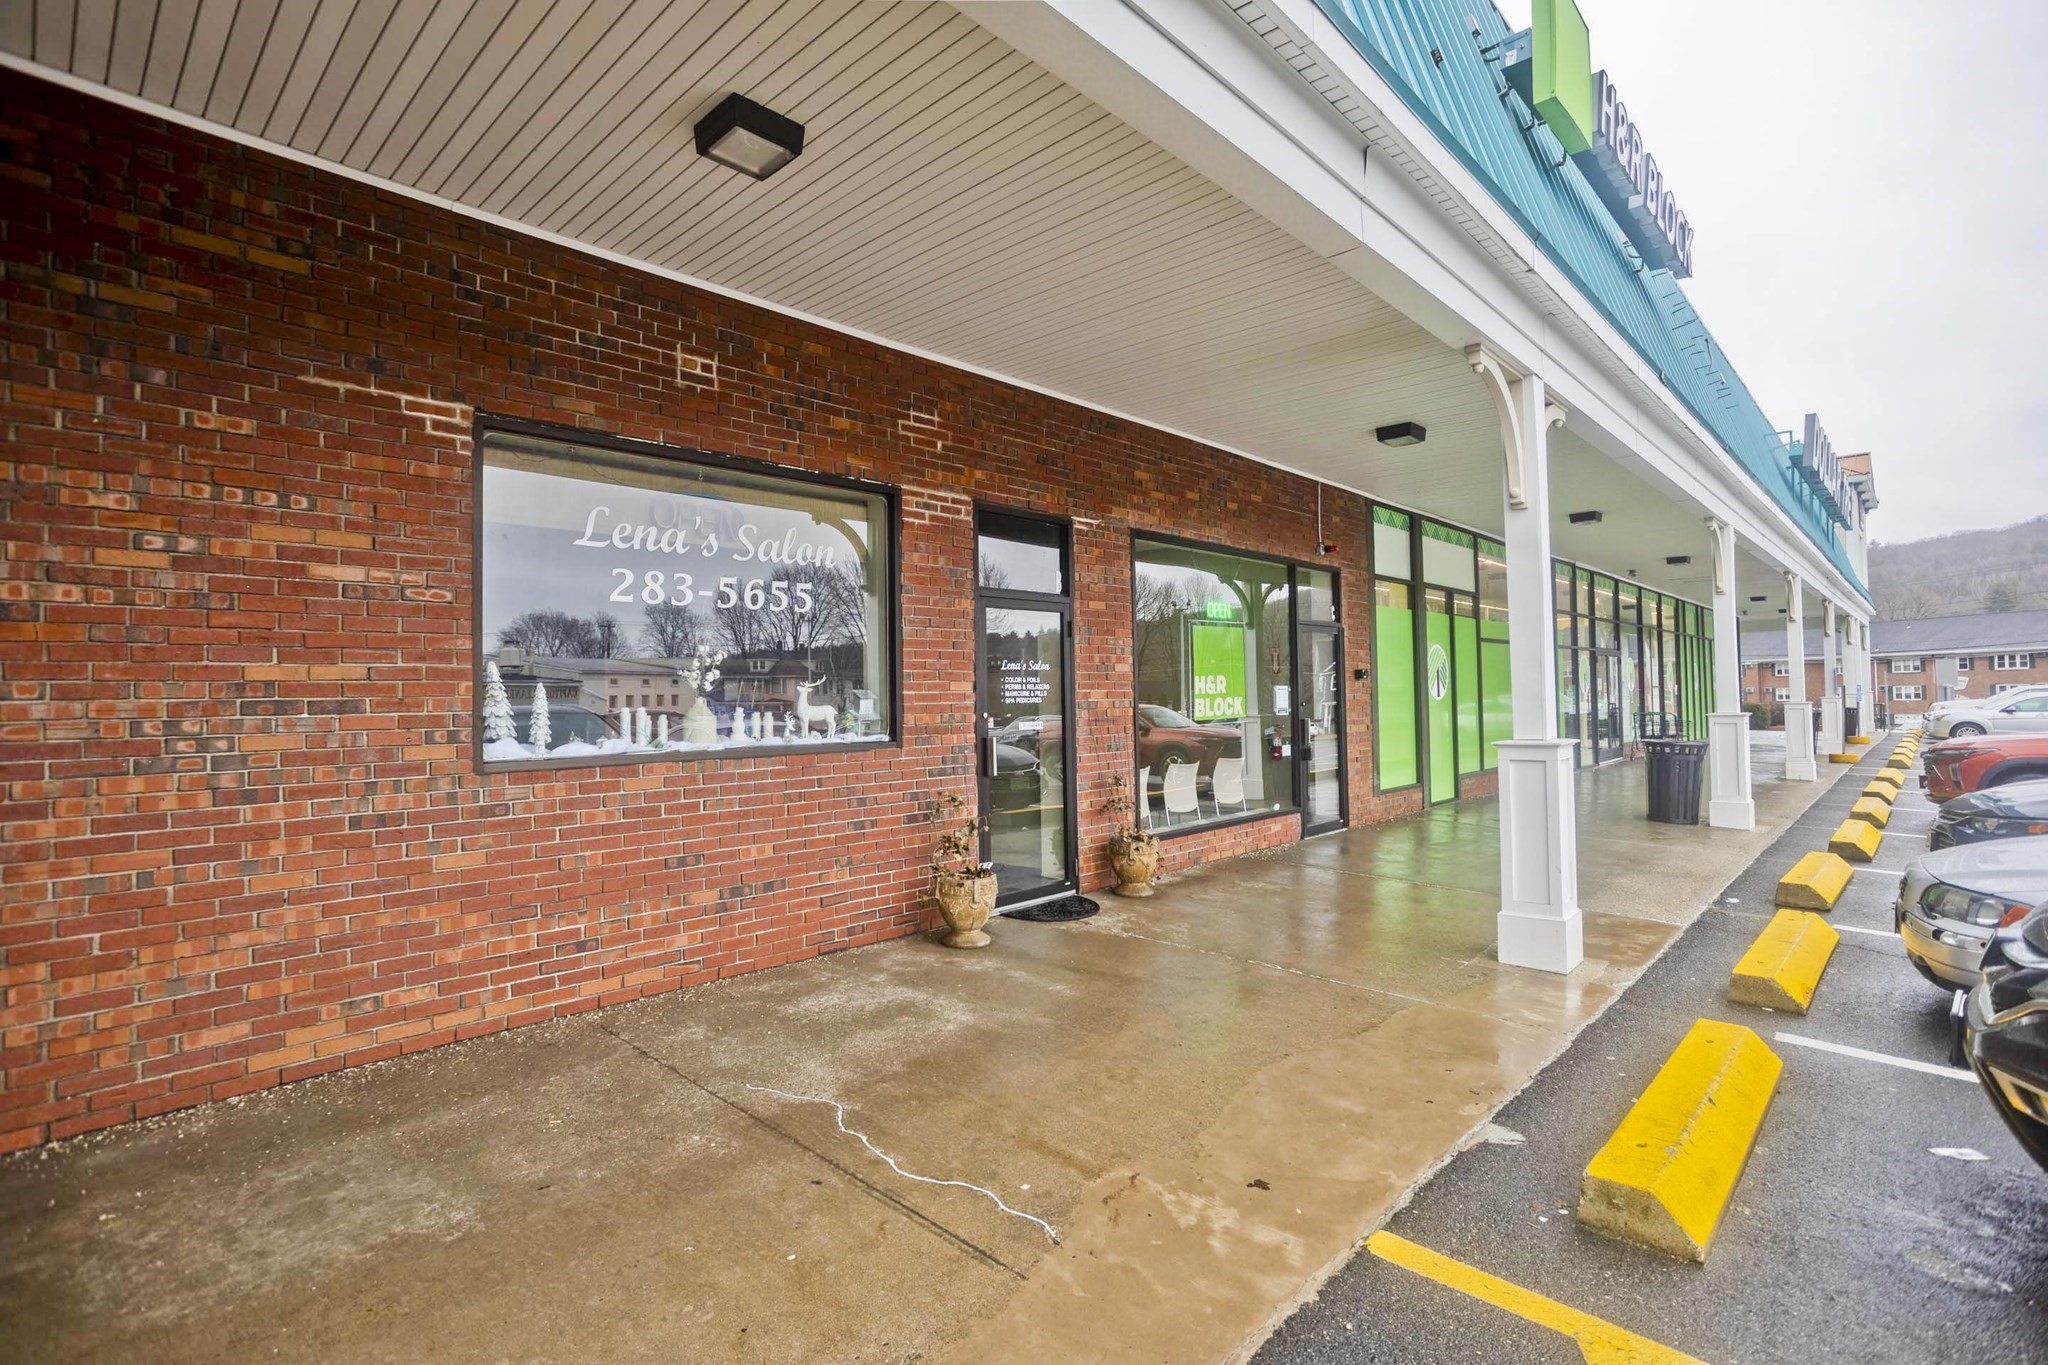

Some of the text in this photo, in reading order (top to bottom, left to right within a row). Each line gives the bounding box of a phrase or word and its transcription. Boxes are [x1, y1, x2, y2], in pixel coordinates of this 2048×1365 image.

[1599, 70, 1694, 278] H&R BLOCK
[573, 505, 838, 569] Lena's Salon
[608, 567, 813, 613] 283-5655
[1206, 602, 1232, 619] OPEN
[1000, 659, 1051, 671] Lena's Salon
[1195, 675, 1227, 694] H&R
[1194, 697, 1244, 718] BLOCK
